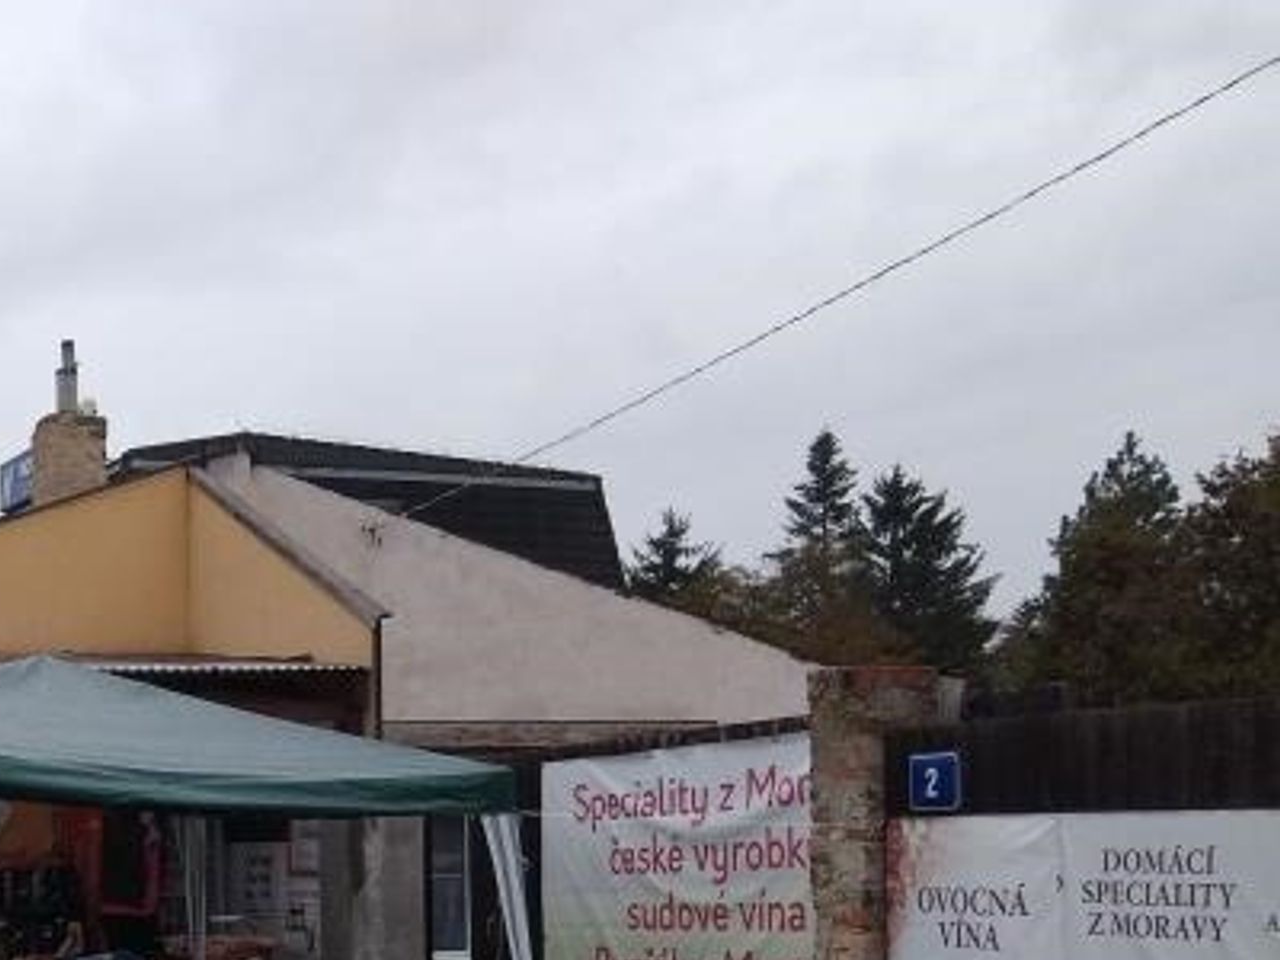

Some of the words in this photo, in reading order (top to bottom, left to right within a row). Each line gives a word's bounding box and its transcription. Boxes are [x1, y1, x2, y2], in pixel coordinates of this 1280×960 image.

[572, 777, 708, 832] Speciality
[719, 783, 736, 811] z
[746, 764, 811, 809] Mor
[923, 767, 940, 798] 2
[1102, 845, 1217, 875] DOMÁCÍ
[626, 888, 729, 931] sudové
[738, 889, 806, 932] vína
[917, 883, 1031, 917] OVOCNÁ
[1080, 879, 1237, 909] SPECIALITY
[937, 918, 1000, 952] VÍNA
[1087, 912, 1105, 936] Z
[1110, 912, 1228, 942] MORAVY
